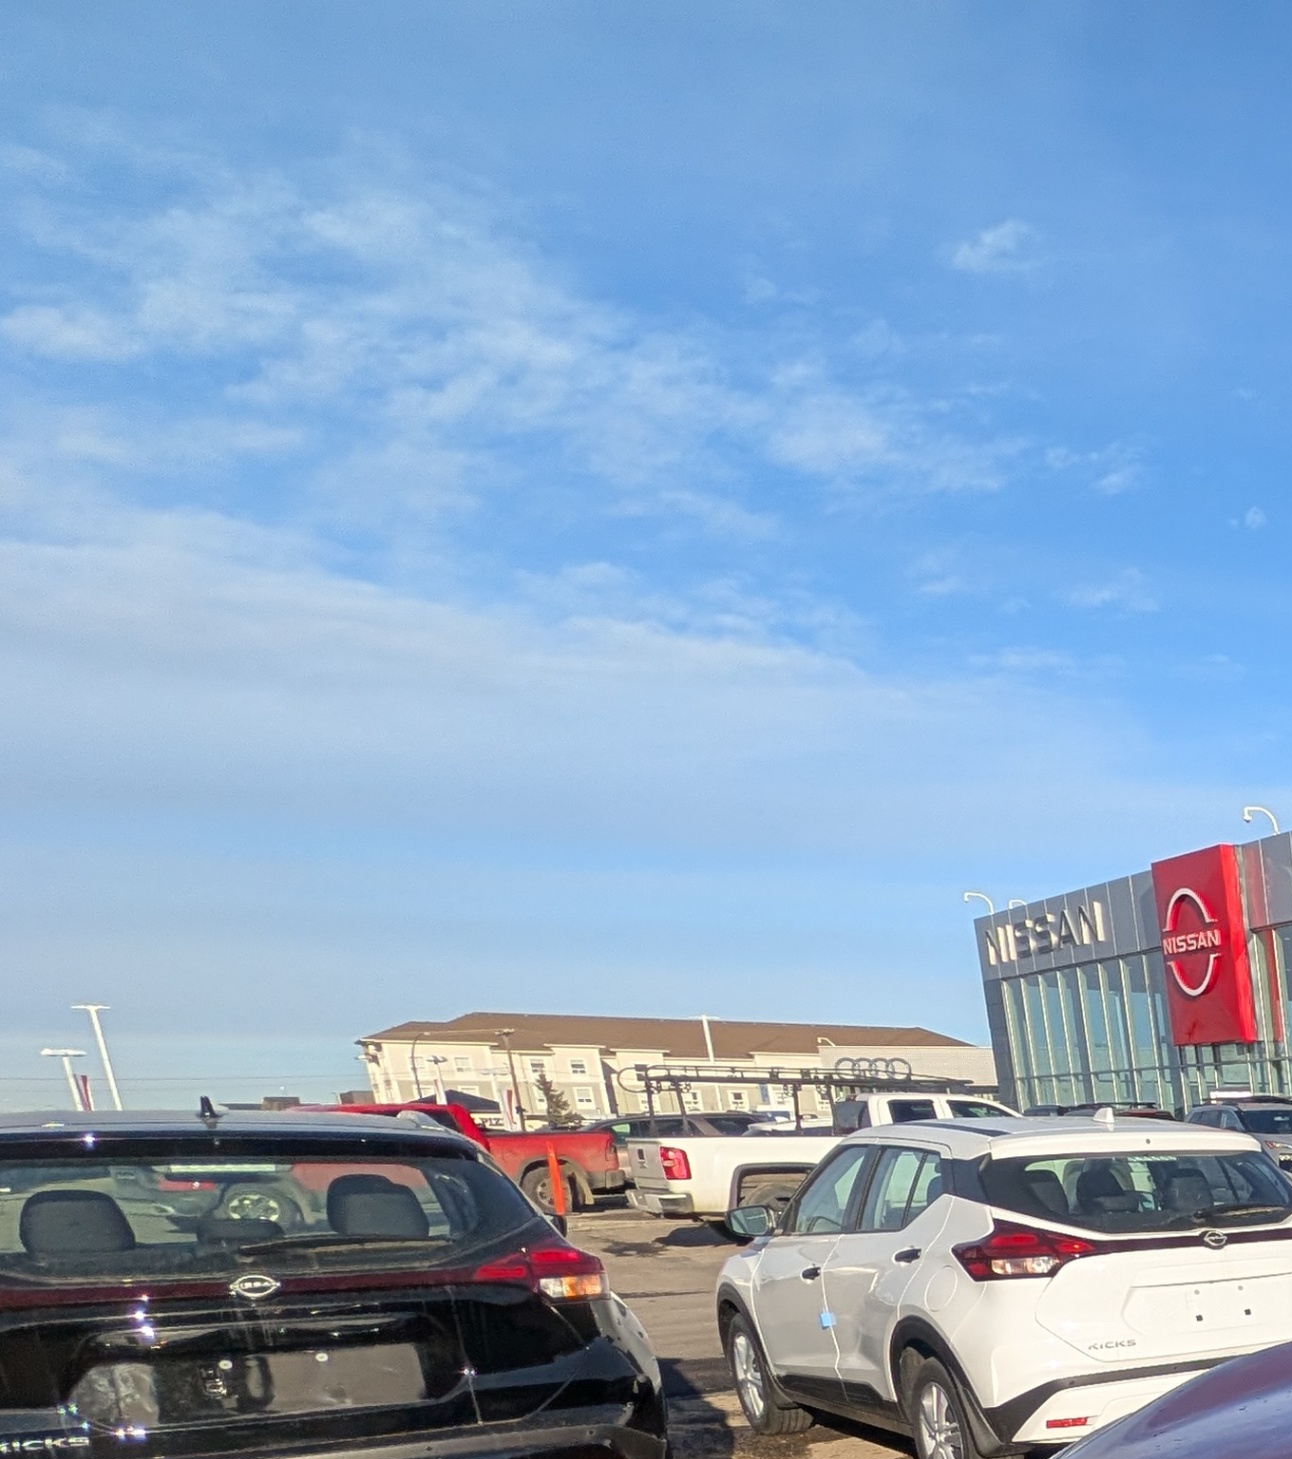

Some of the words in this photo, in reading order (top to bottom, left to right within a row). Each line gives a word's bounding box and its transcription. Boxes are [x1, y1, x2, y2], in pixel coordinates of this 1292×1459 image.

[984, 901, 1106, 966] NISSAN
[1163, 930, 1221, 955] NISSAN
[1088, 1339, 1137, 1351] KICKS
